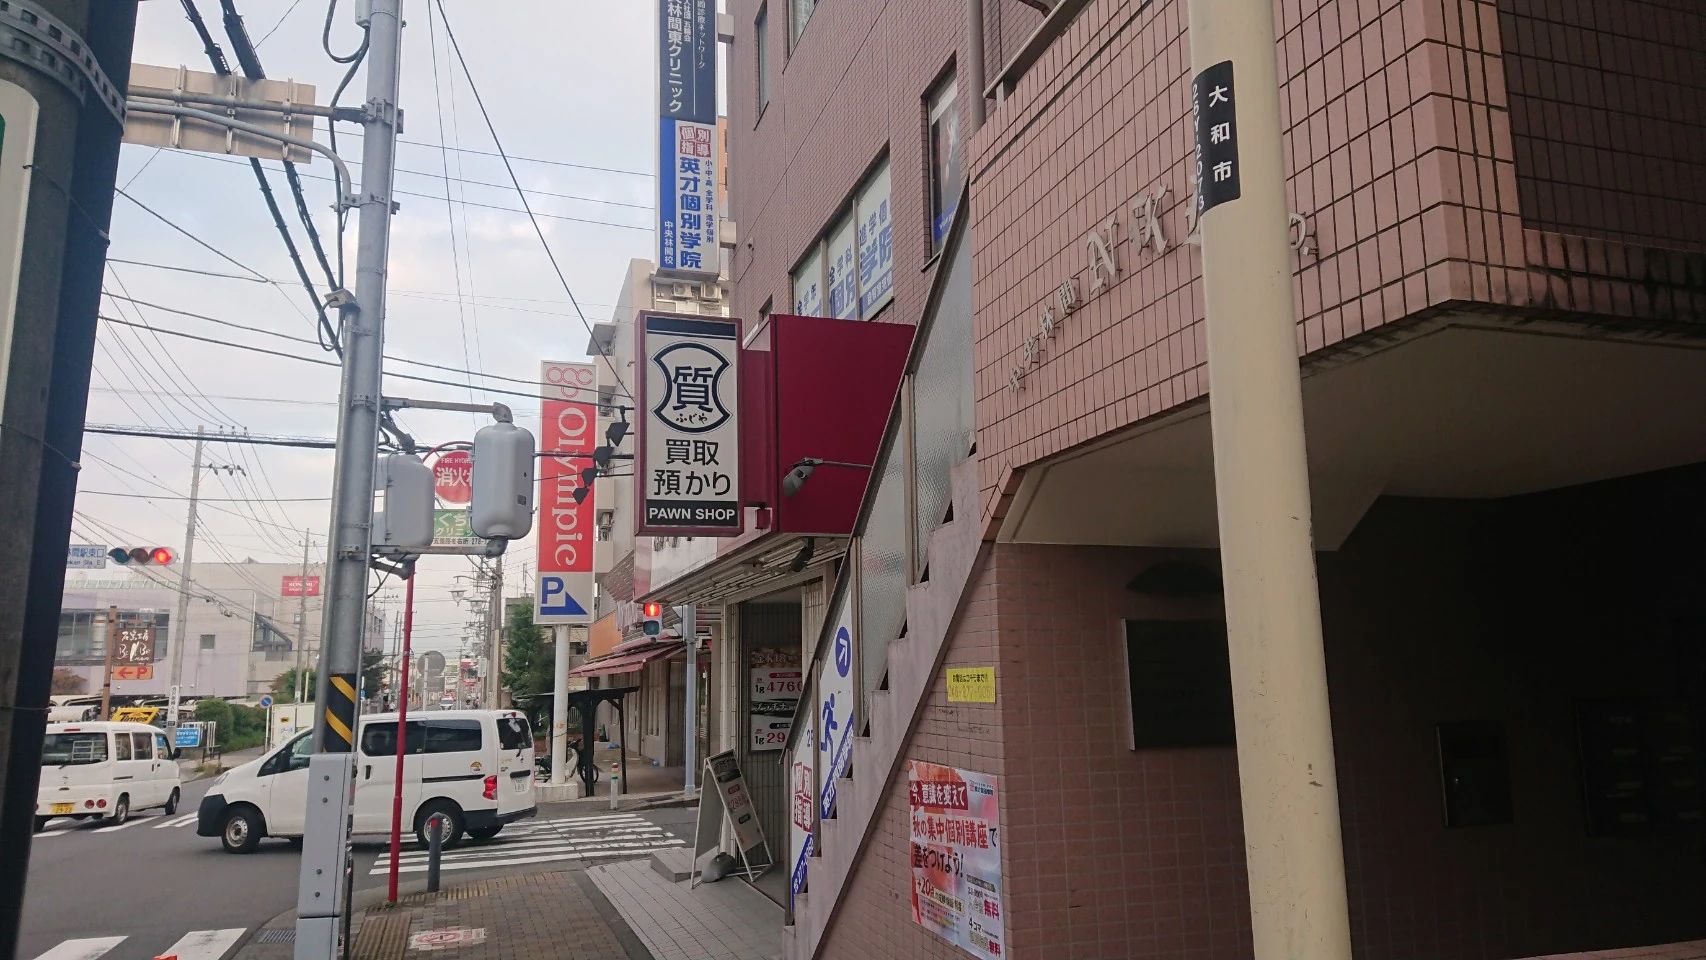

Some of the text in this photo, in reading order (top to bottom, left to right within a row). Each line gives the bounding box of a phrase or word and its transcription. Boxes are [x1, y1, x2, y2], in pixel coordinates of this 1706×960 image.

[667, 0, 683, 112] 林間東クリニック
[1208, 85, 1233, 183] 大和市
[679, 157, 702, 269] 英才個別学院
[672, 366, 714, 413] 質
[666, 438, 719, 466] 買取
[551, 407, 588, 566] Olympic
[653, 469, 731, 496] 預かり
[649, 507, 736, 521] PAWN SHOP
[541, 576, 564, 604] P
[136, 667, 148, 679] P
[912, 815, 998, 849] 秋の集中個別講座で
